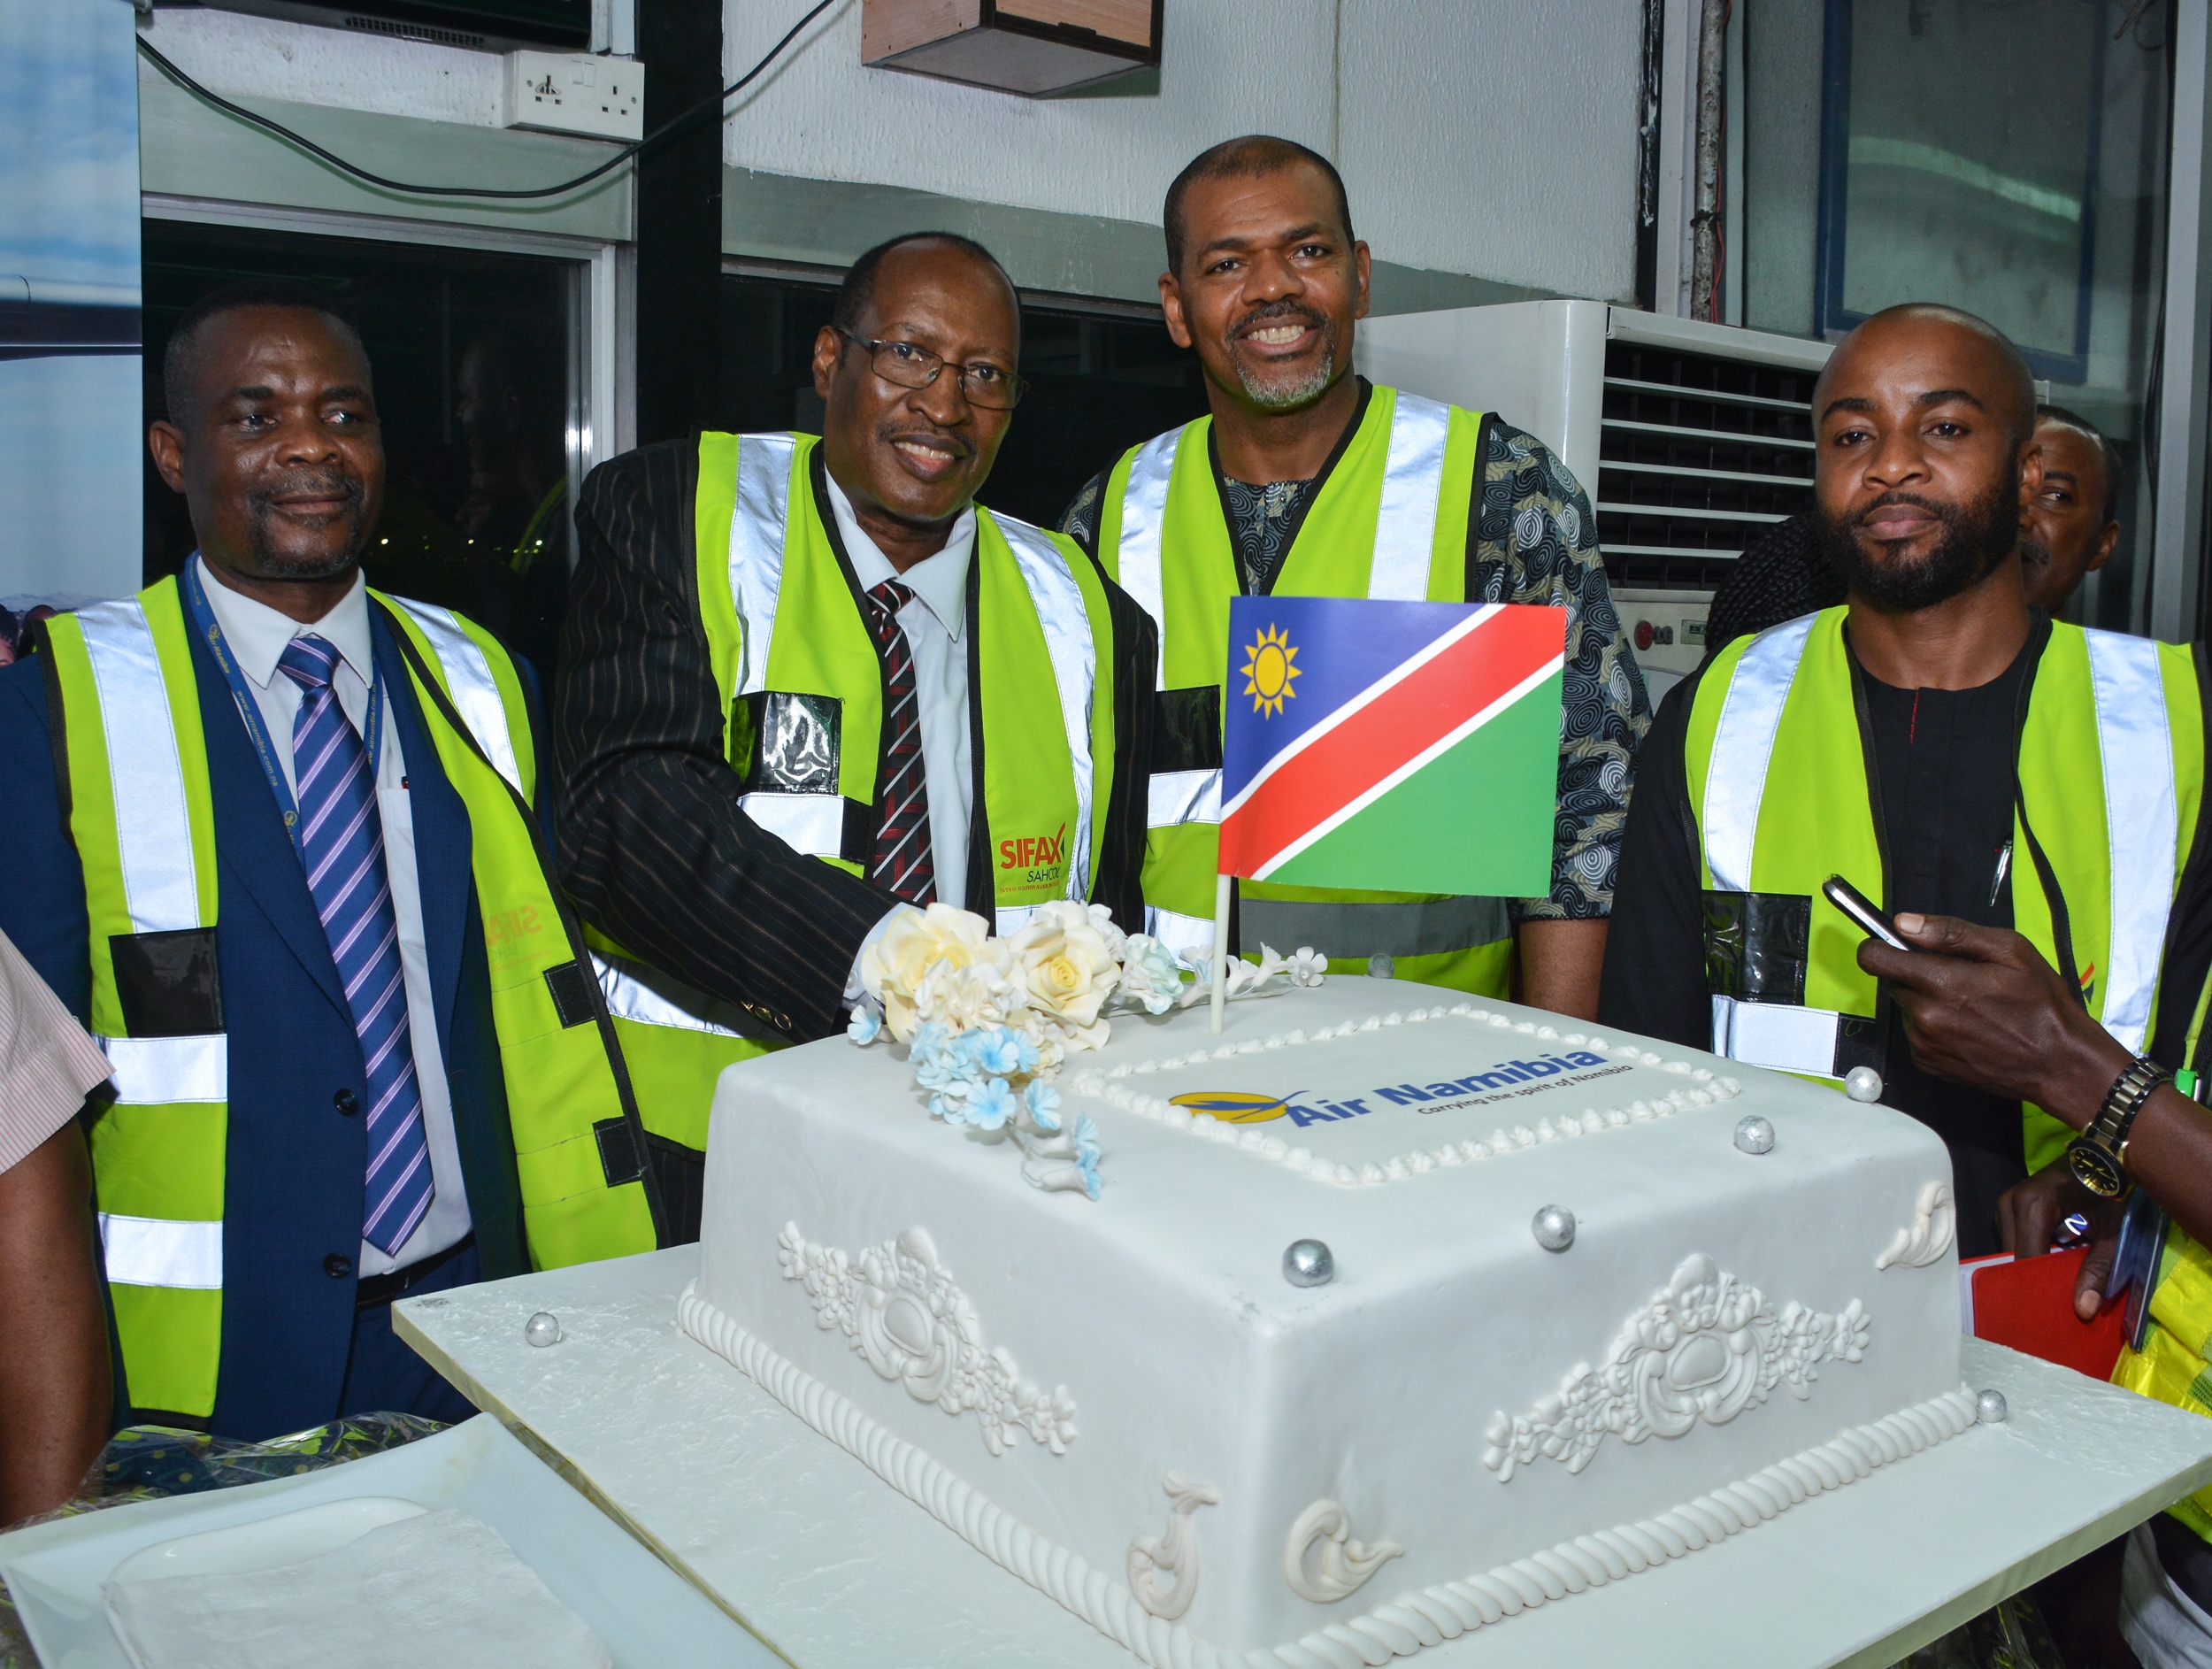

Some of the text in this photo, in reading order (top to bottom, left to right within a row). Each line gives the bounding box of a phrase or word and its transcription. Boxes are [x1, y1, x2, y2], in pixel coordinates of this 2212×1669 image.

[1654, 626, 1673, 645] LG
[1000, 821, 1066, 870] SIFAX
[1286, 1050, 1609, 1128] Air Namibia
[1417, 1065, 1634, 1115] Carrying the spirit of Namibia
